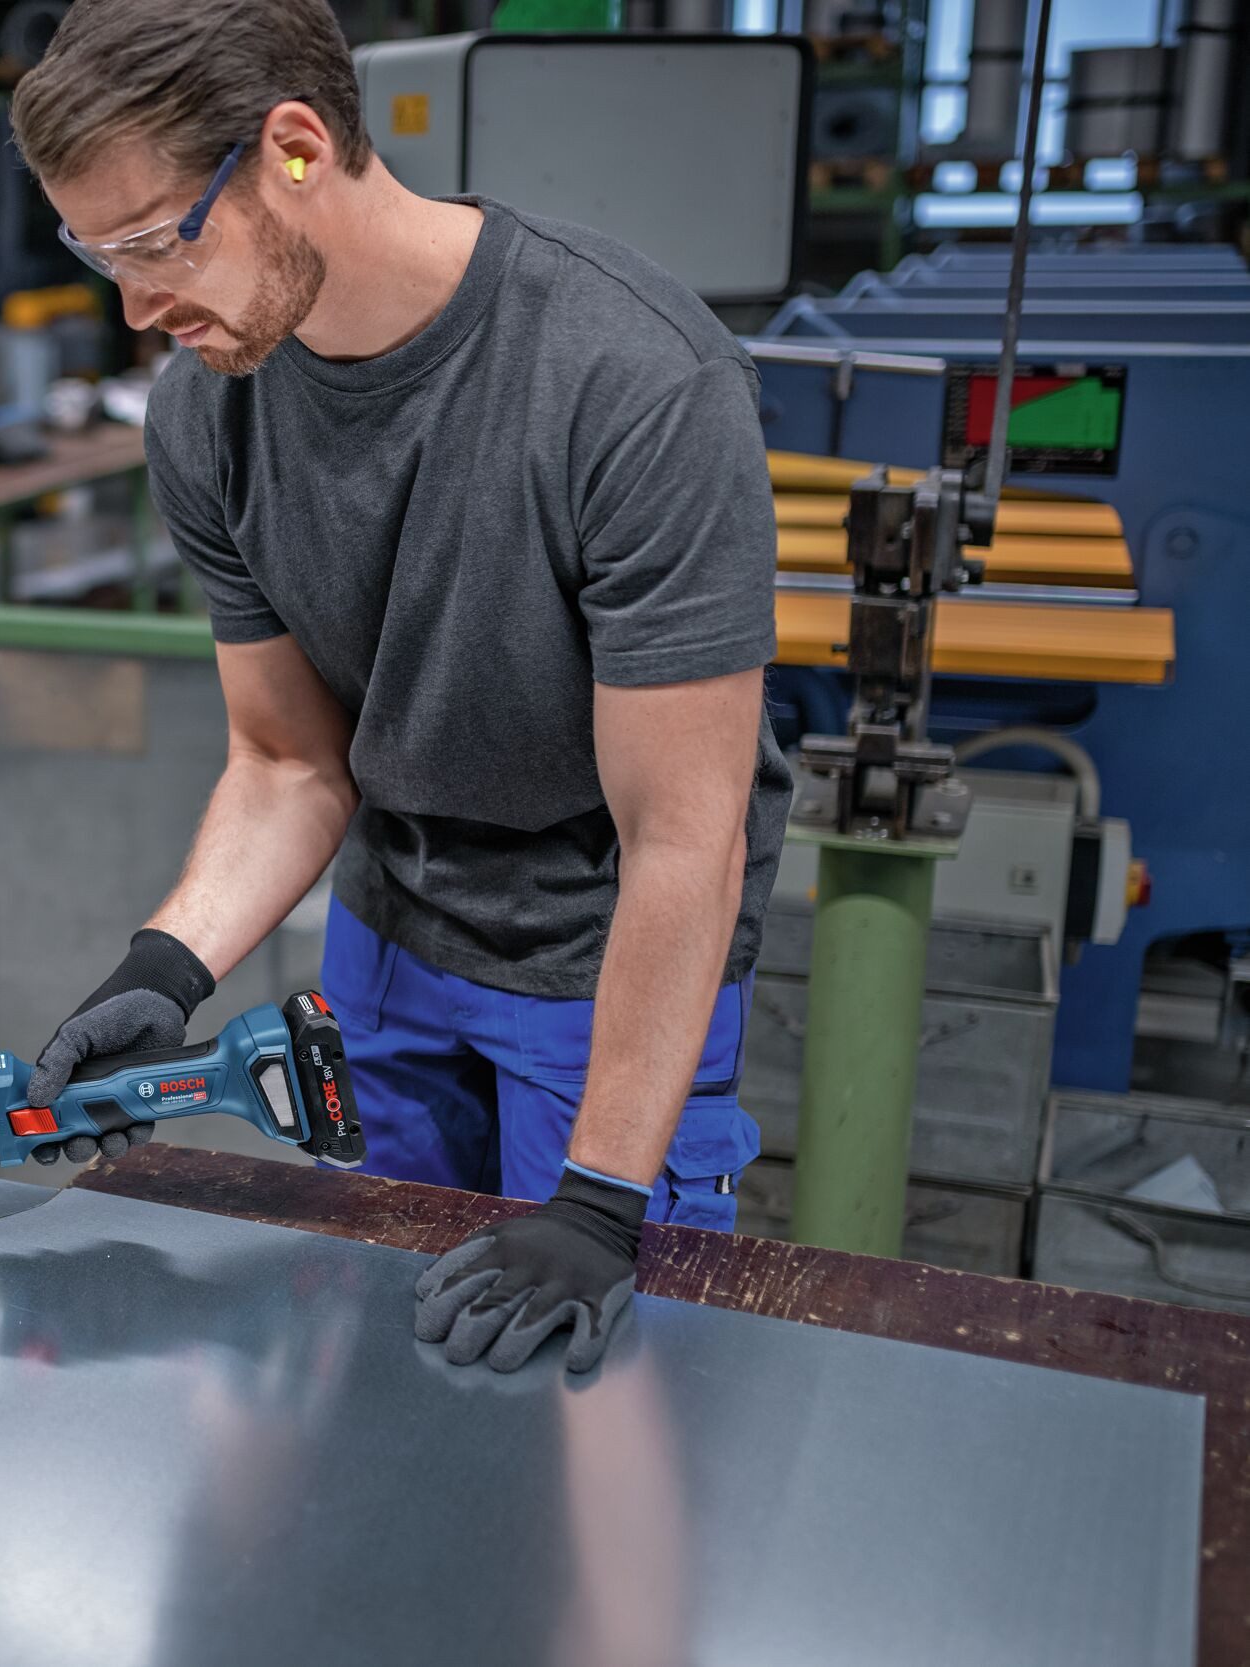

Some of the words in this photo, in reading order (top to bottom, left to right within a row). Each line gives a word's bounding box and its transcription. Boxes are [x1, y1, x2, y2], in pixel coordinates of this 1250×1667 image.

[322, 1066, 334, 1080] 18V
[160, 1077, 206, 1093] BOSCH
[162, 1093, 194, 1101] Professional
